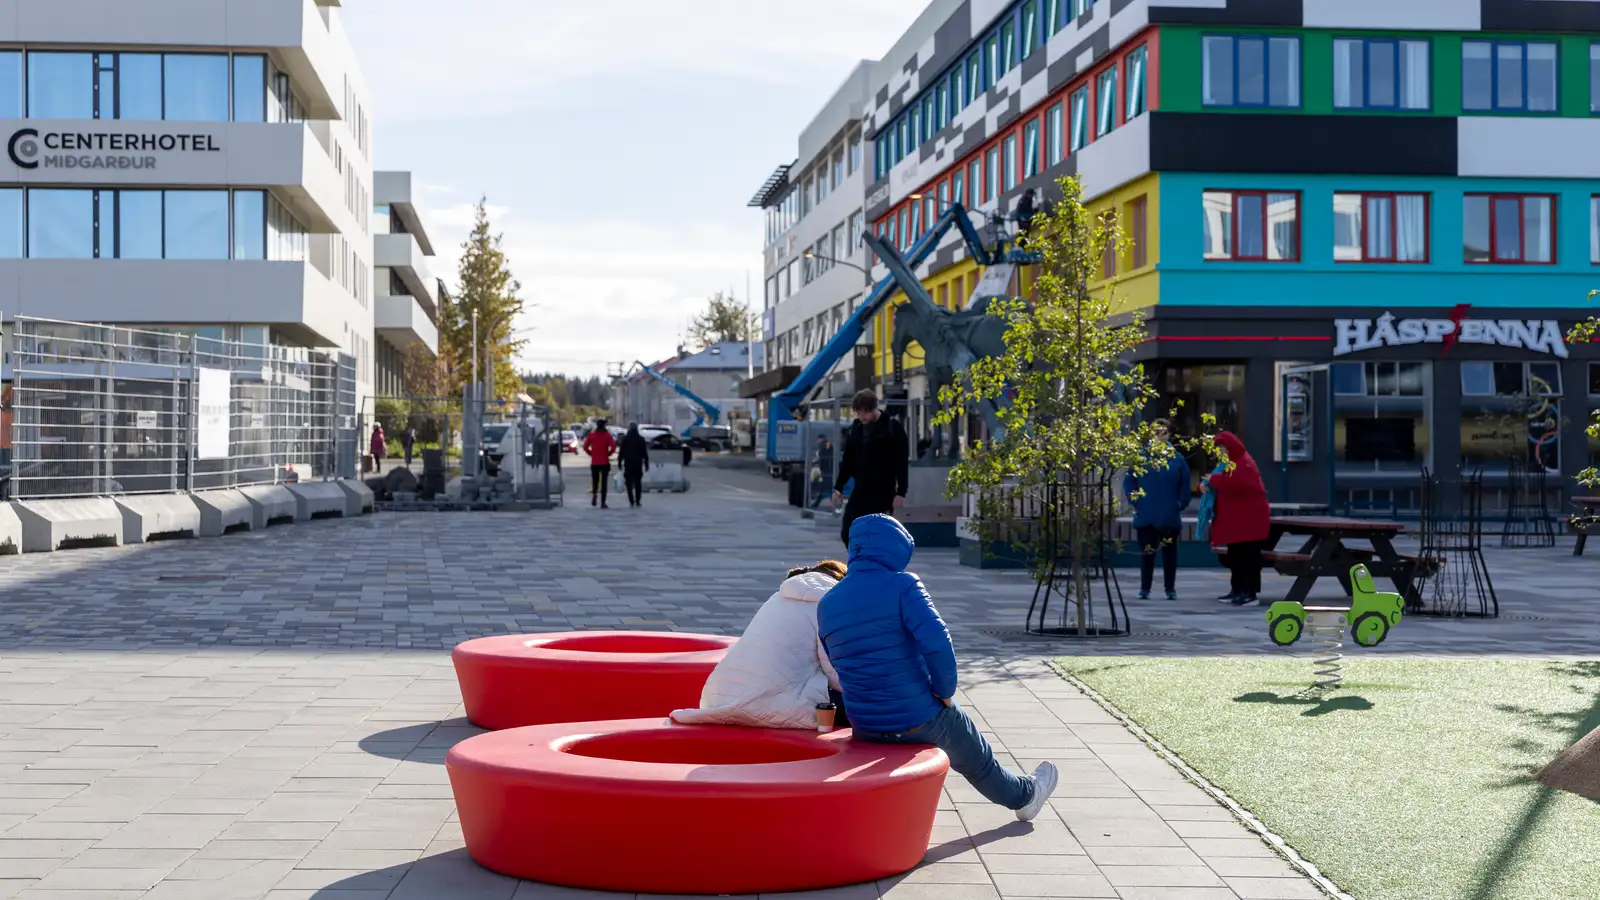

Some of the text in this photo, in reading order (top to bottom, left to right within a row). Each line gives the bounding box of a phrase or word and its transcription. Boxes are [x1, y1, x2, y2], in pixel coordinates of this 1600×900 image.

[44, 132, 220, 151] CENTERHOTEL
[44, 155, 157, 170] MIÐGARÐUR
[1333, 311, 1569, 359] HÁSPENNA
